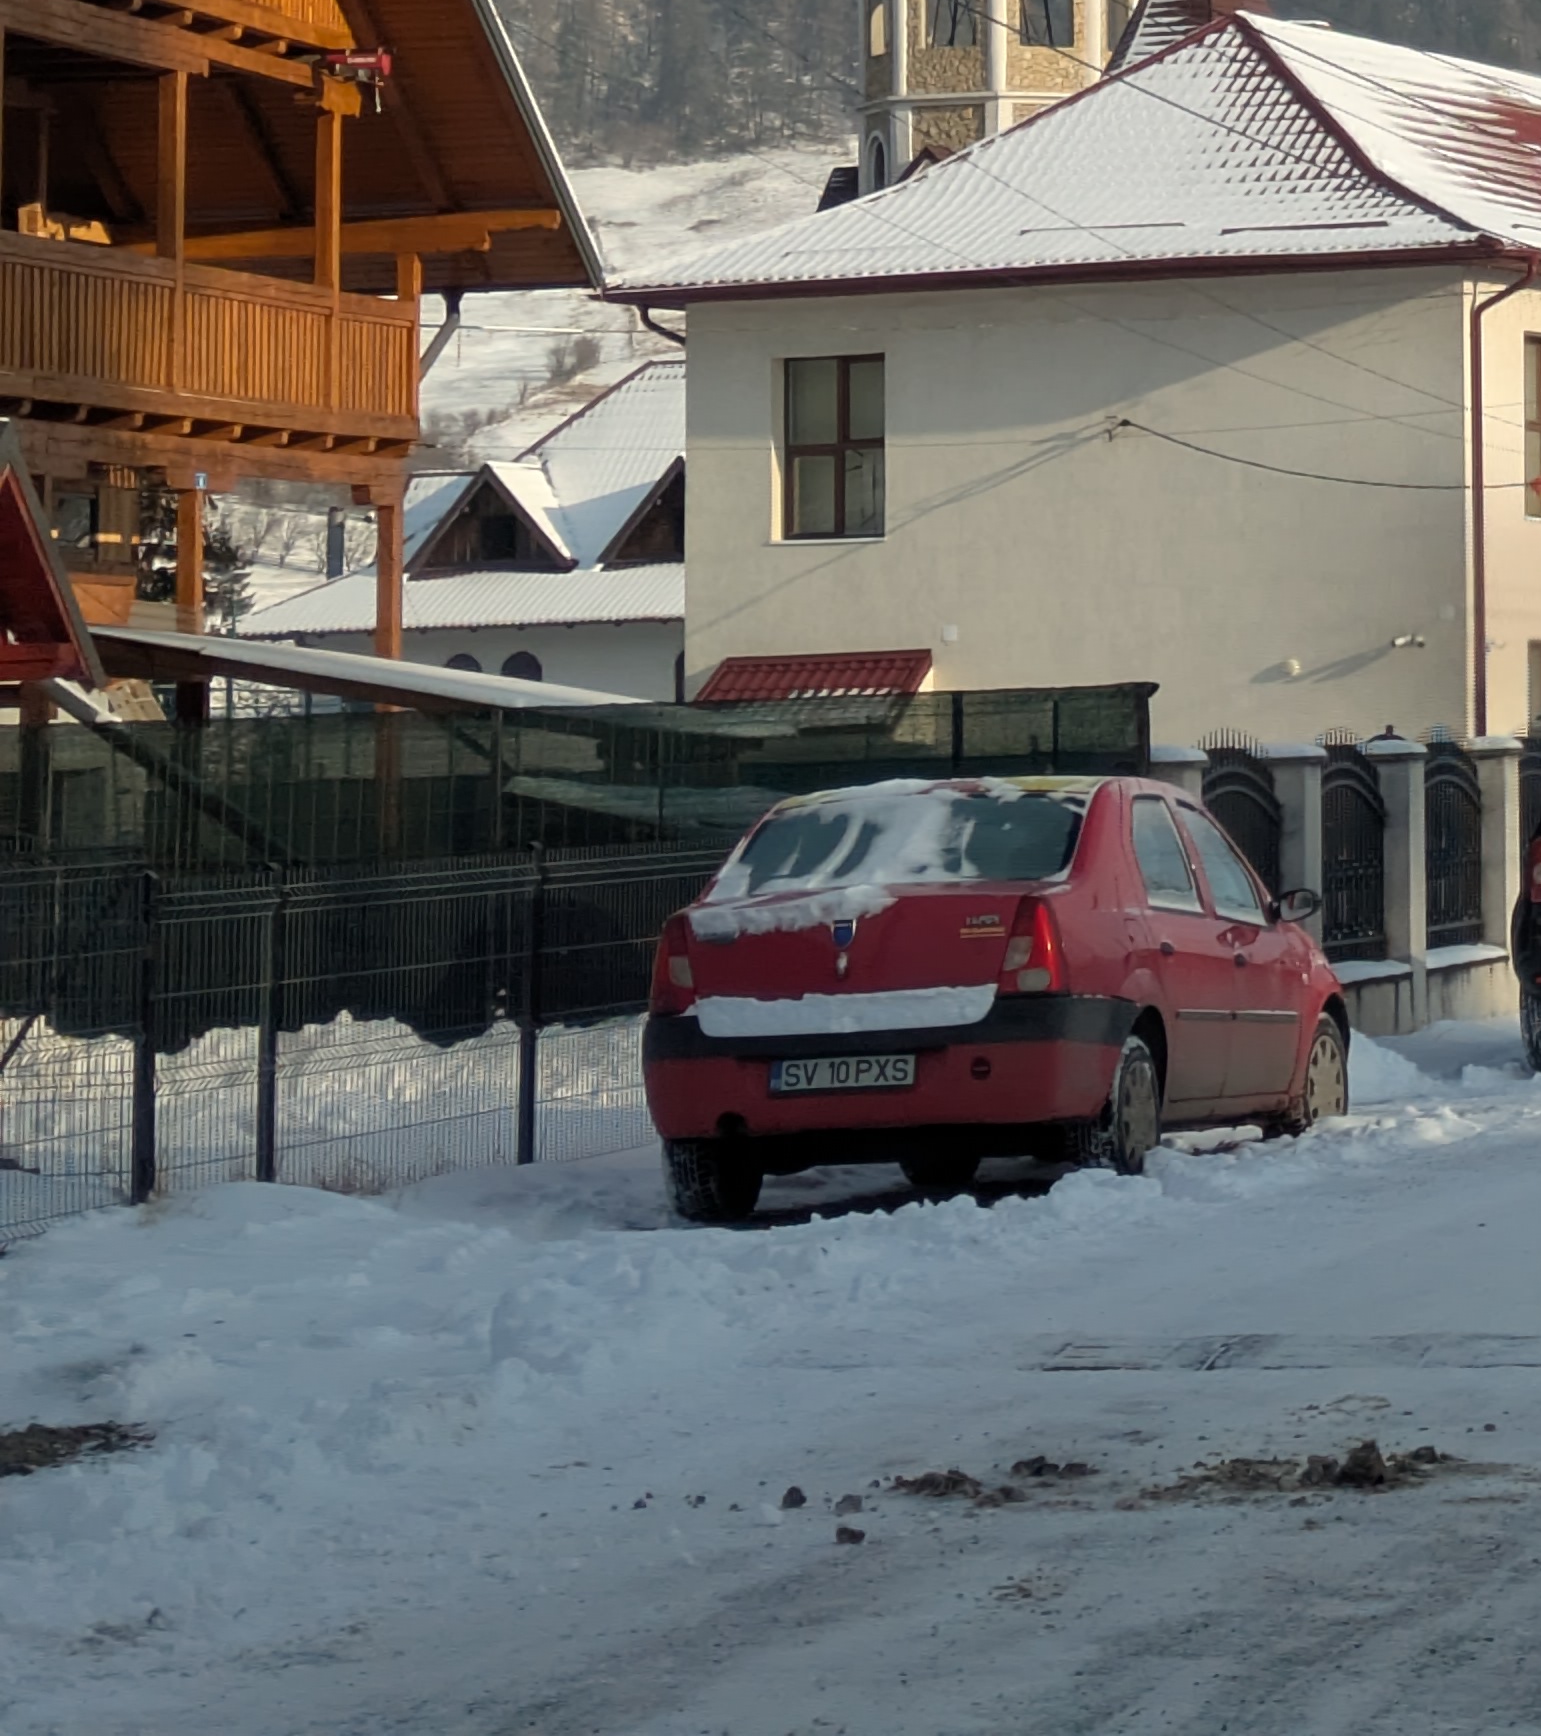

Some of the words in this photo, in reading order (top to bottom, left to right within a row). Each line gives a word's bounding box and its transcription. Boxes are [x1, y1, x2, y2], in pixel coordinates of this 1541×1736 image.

[784, 1063, 818, 1087] SV
[829, 1061, 850, 1084] 10
[855, 1059, 909, 1083] PXS
